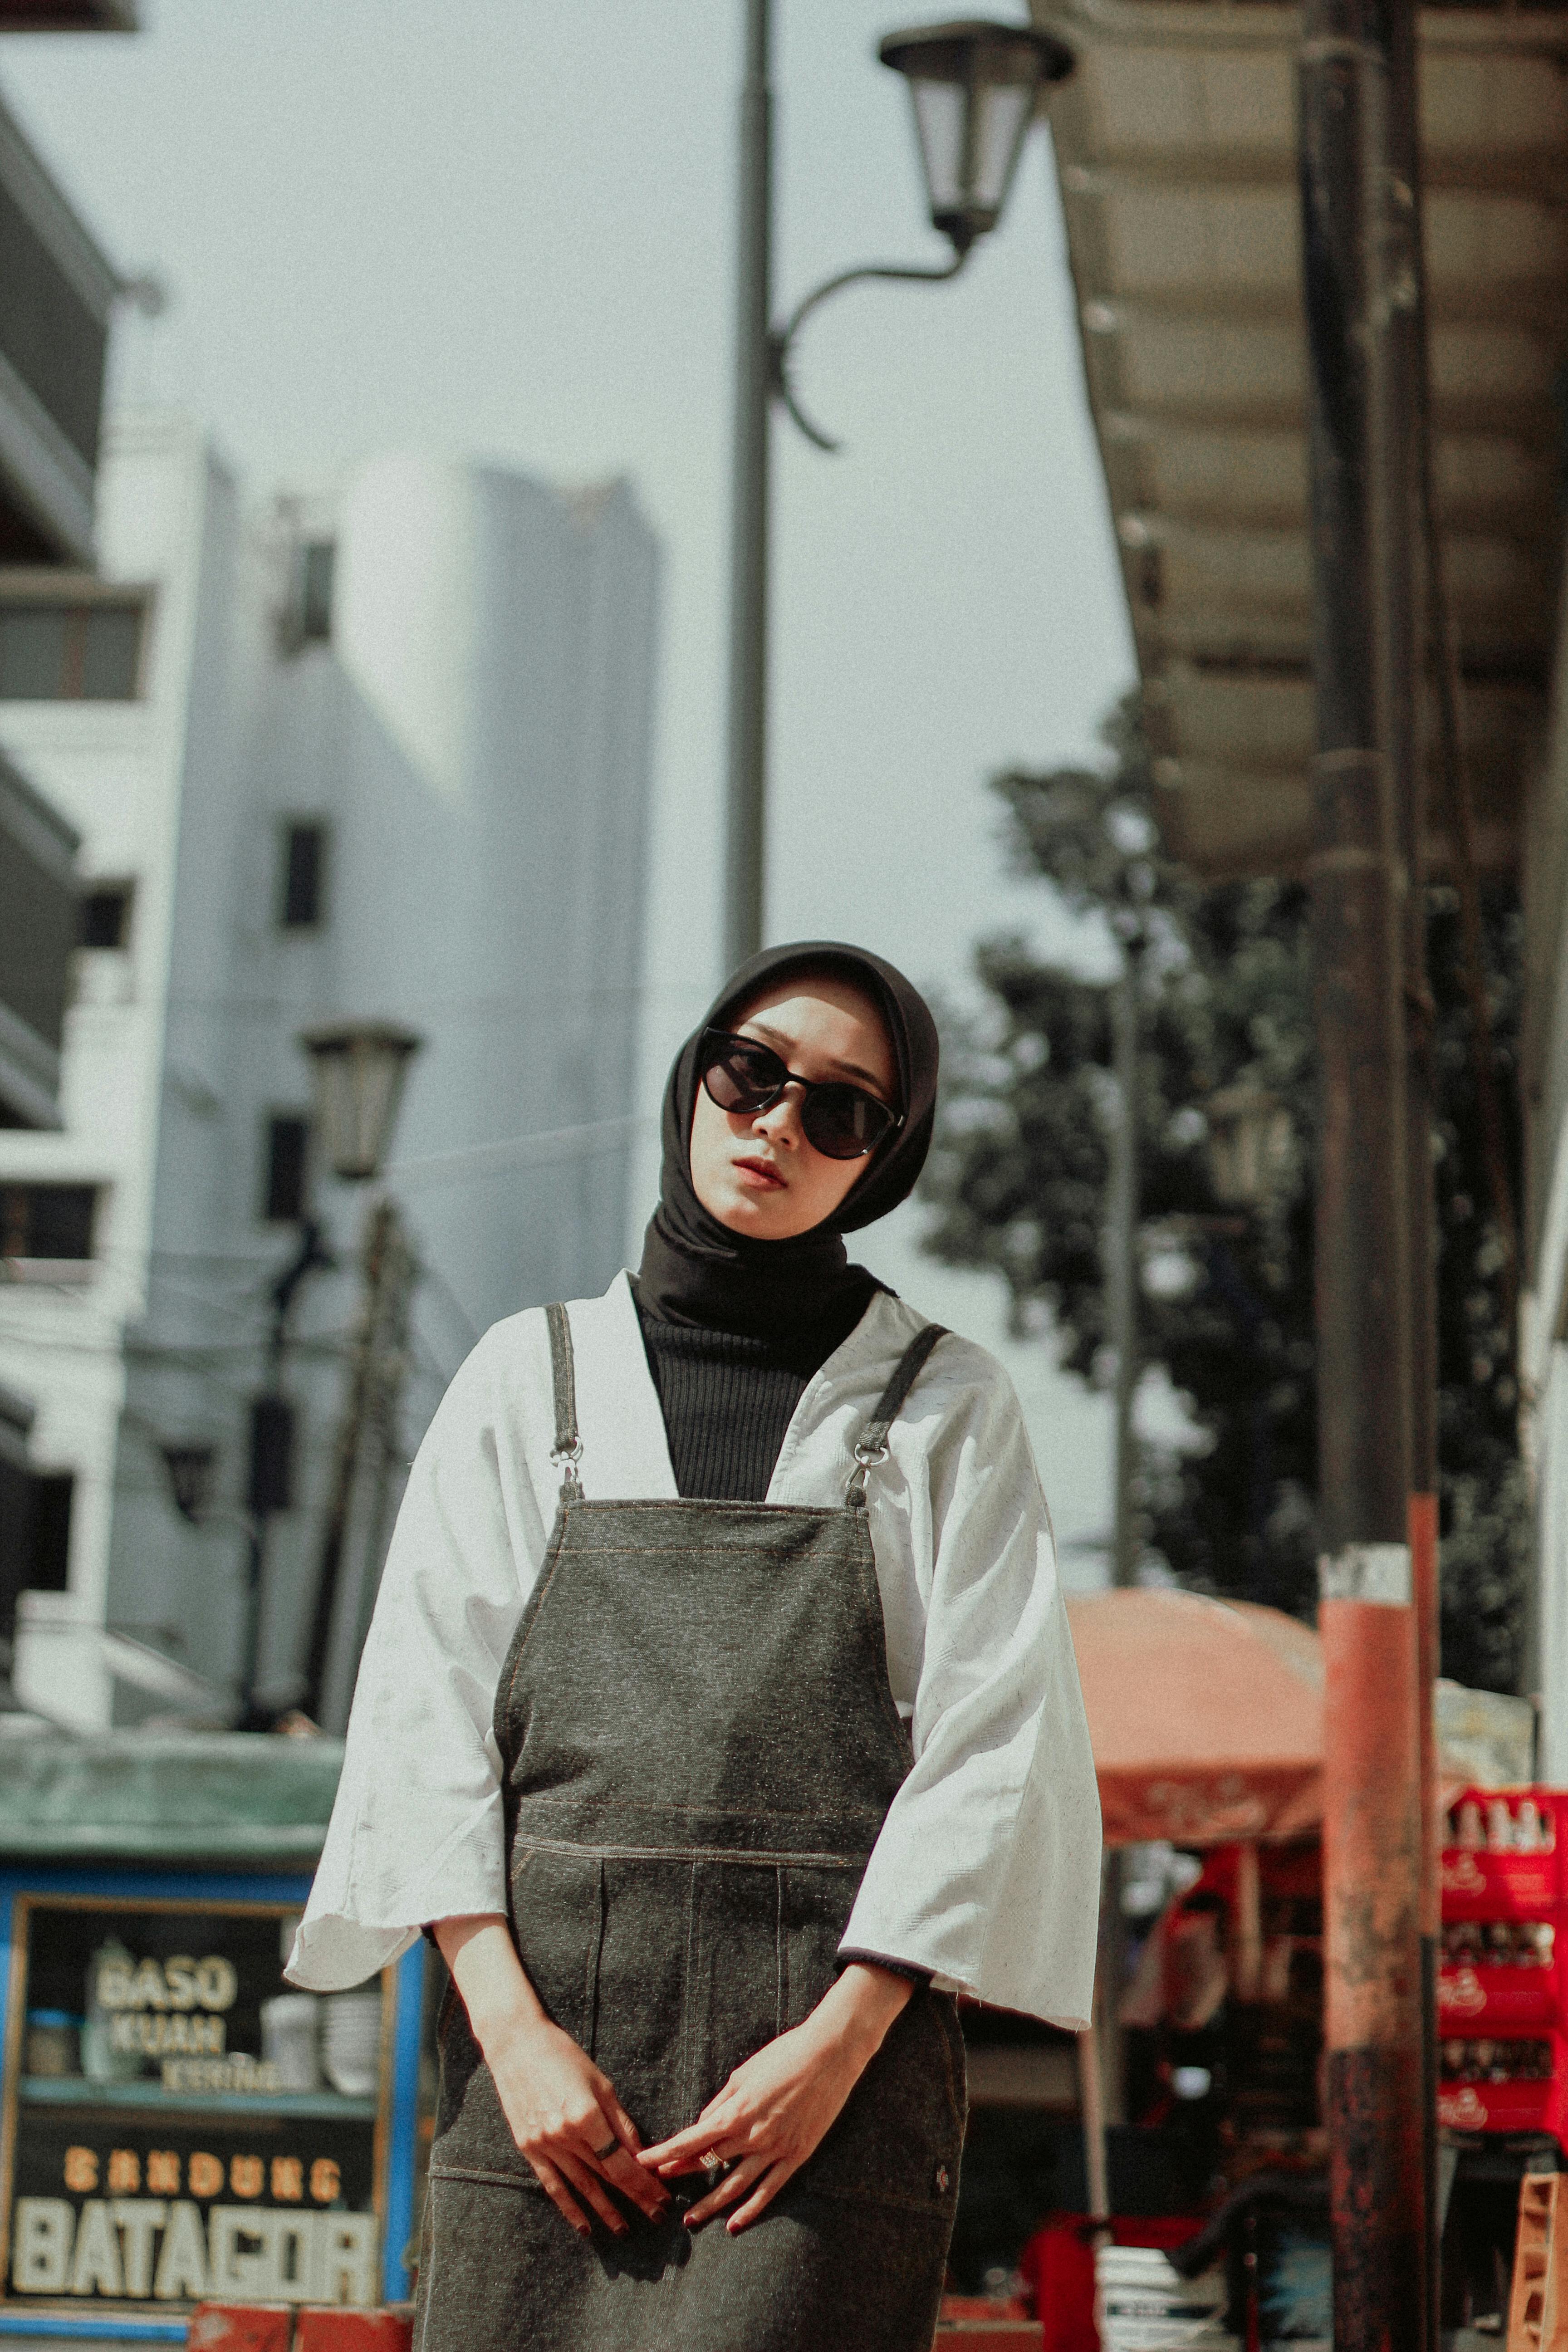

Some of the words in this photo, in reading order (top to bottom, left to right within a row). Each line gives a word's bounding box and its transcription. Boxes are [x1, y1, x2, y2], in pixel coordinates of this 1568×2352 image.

[97, 1955, 238, 2011] BASO
[64, 2146, 341, 2202] BANDUNG
[13, 2196, 380, 2305] BATAGOR
